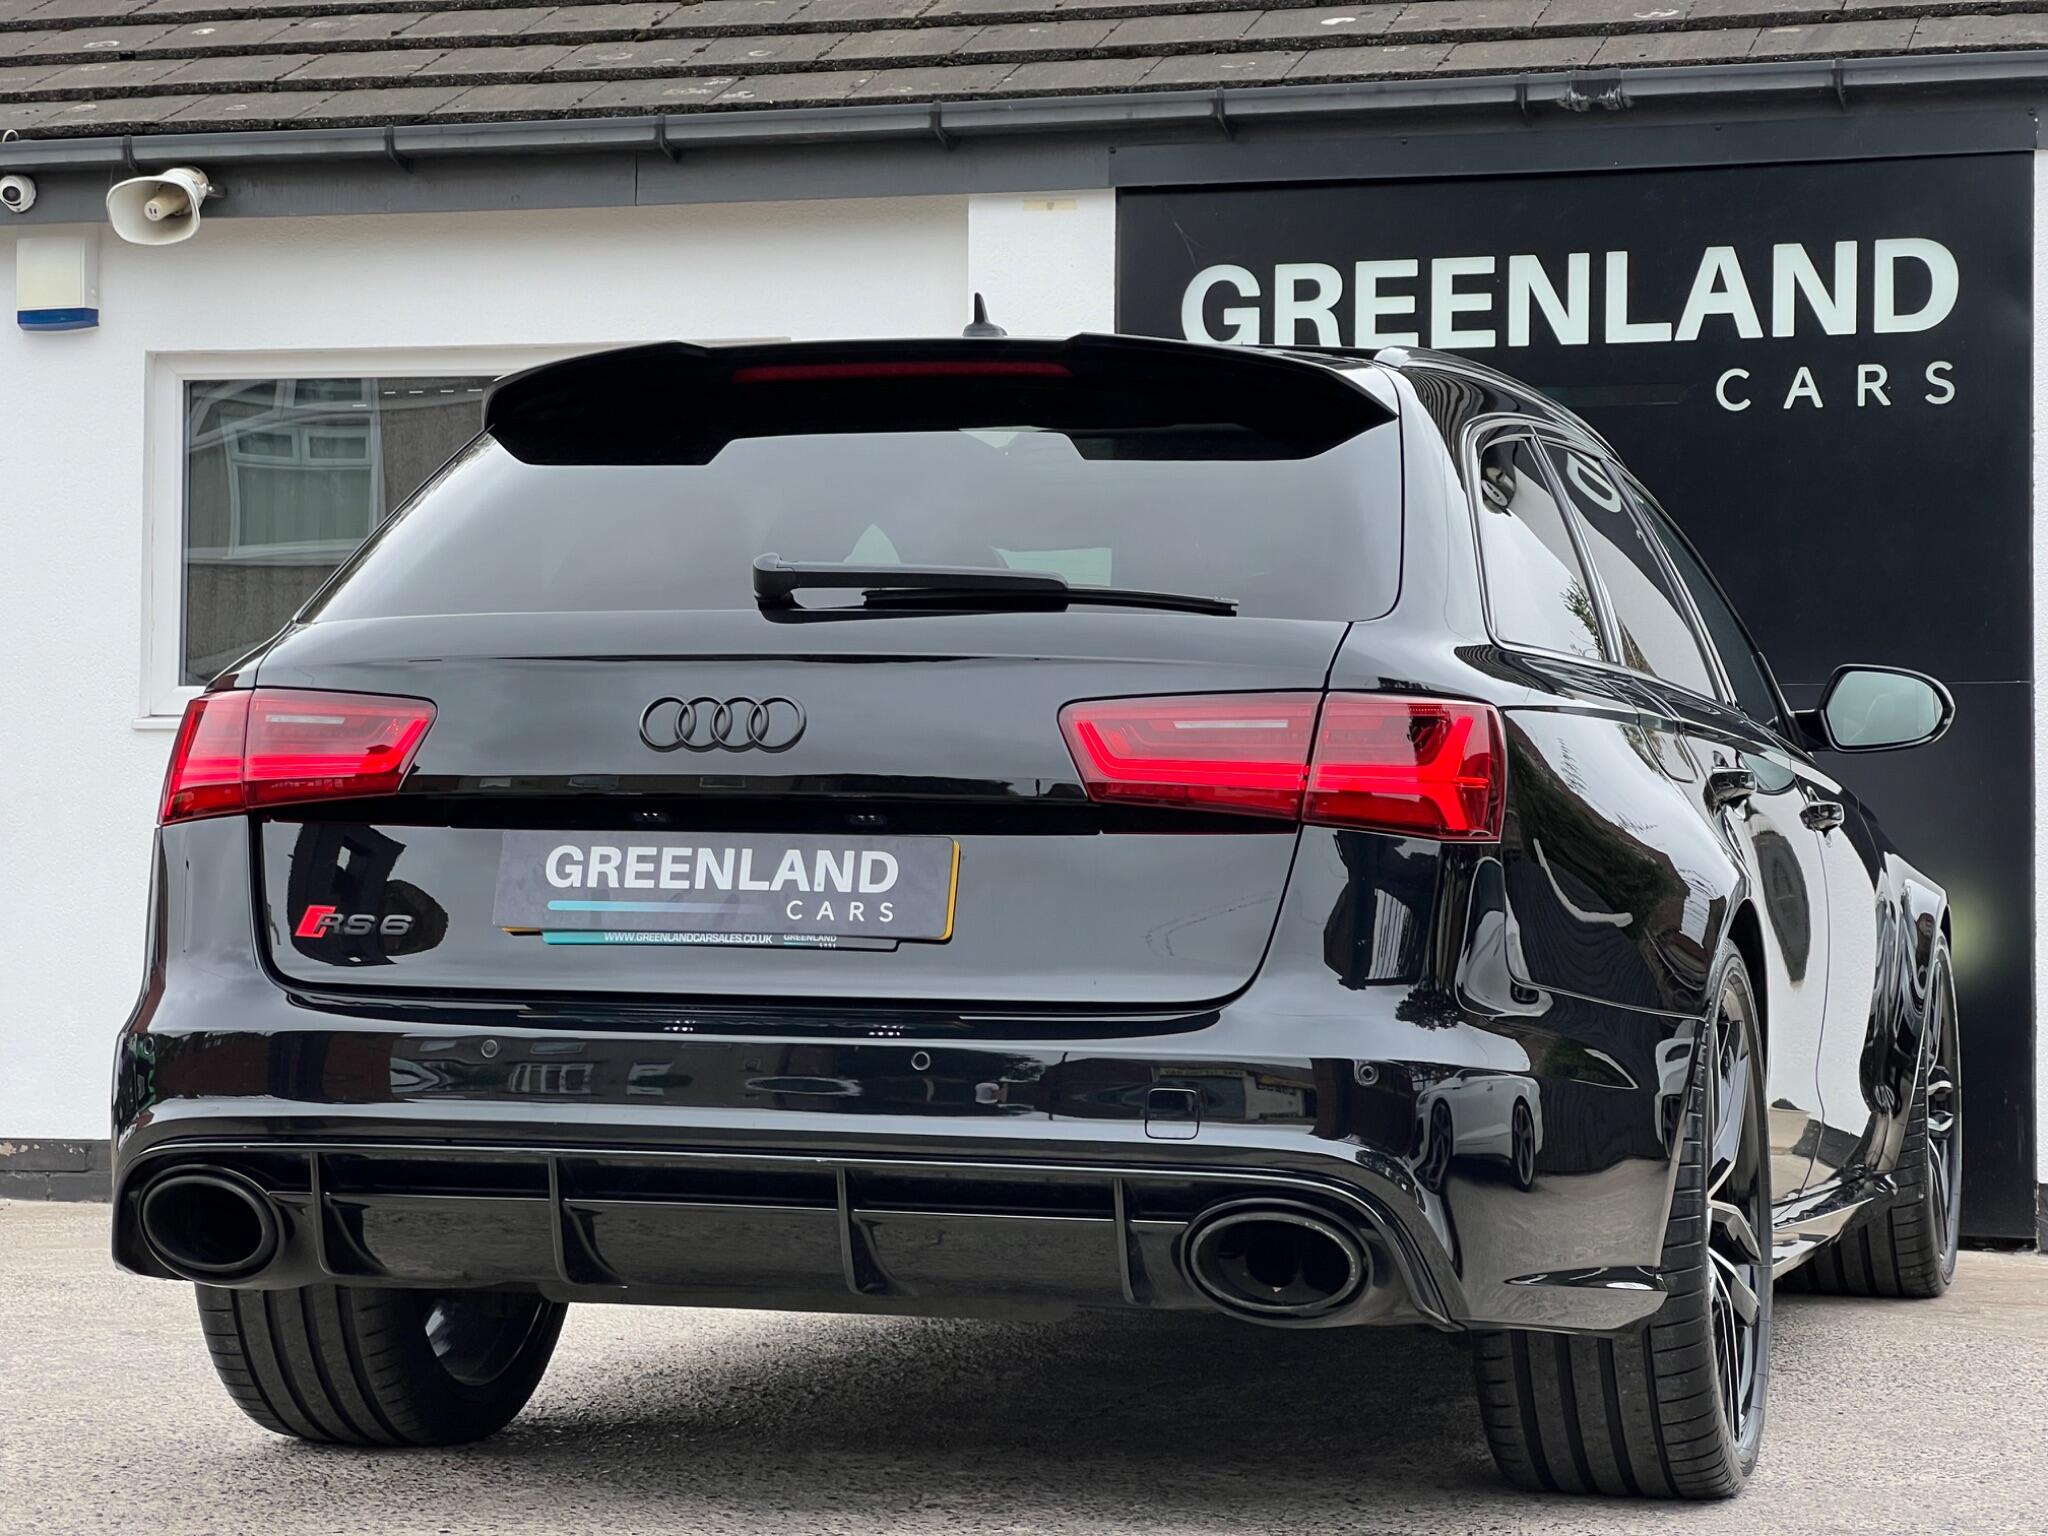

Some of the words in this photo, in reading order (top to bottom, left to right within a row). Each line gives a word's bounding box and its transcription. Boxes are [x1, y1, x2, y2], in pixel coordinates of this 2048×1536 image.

[1181, 237, 1960, 347] GREENLAND
[1715, 361, 1957, 411] CARS
[545, 845, 899, 893] GREENLAND
[786, 900, 894, 922] CARS
[603, 932, 773, 944] WWW.GREENLANDCARSALES.CO.UK
